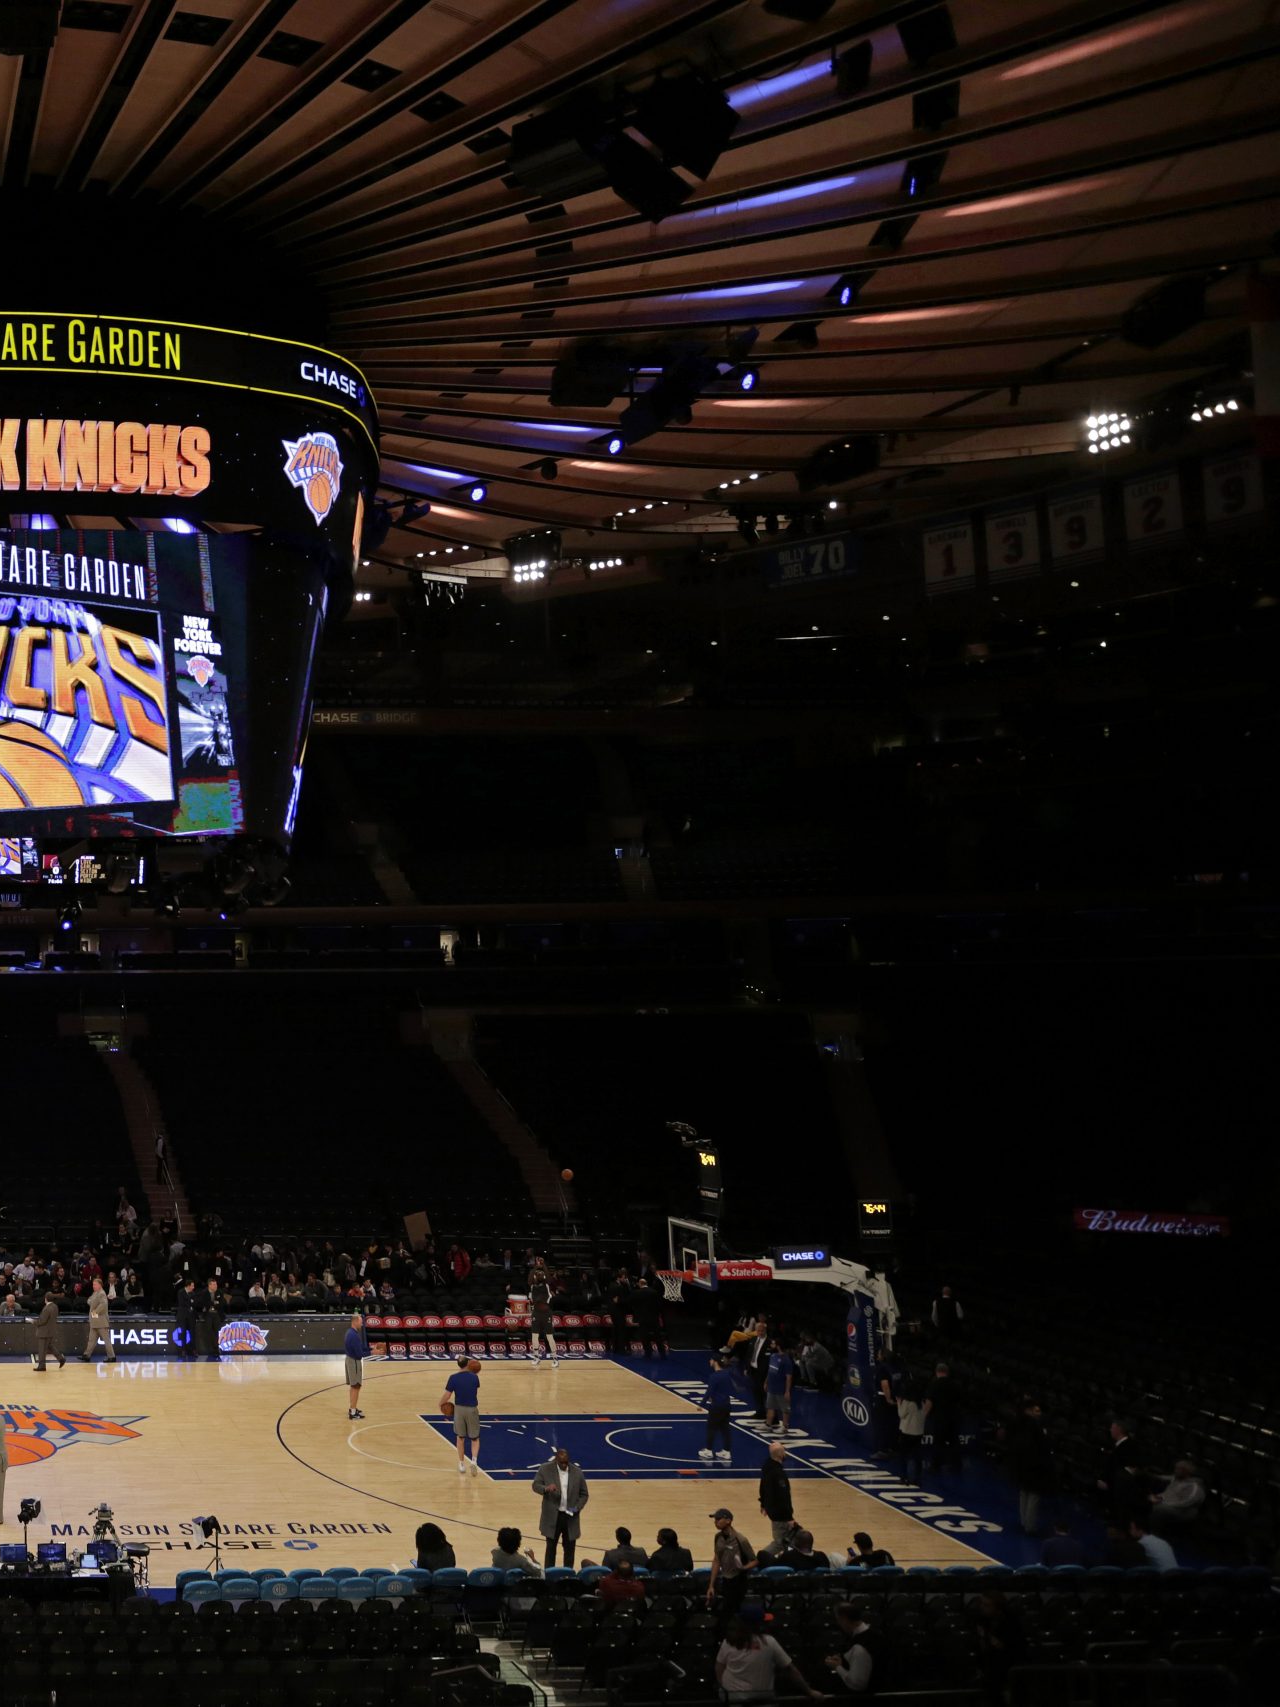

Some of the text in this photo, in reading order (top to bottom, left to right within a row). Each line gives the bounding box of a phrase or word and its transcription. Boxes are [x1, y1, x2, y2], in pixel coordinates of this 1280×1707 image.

[68, 319, 182, 371] GARDEN
[300, 362, 357, 399] CHASE
[26, 419, 211, 497] KNICKS
[1142, 497, 1166, 533] 2
[1002, 531, 1024, 564] 3
[1066, 516, 1088, 549] 9
[808, 541, 846, 575] 70
[943, 544, 957, 576] 1
[64, 552, 146, 600] GARDEN
[183, 615, 210, 630] NEW
[183, 627, 213, 643] YORK
[174, 638, 222, 656] FOREVER
[312, 712, 417, 723] CHASE BRIDGE
[1082, 1208, 1221, 1236] Budweiser
[782, 1252, 814, 1261] CHASE
[846, 1404, 865, 1423] KIA
[809, 1458, 1004, 1534] KNICKS
[287, 1522, 393, 1536] GARDEN
